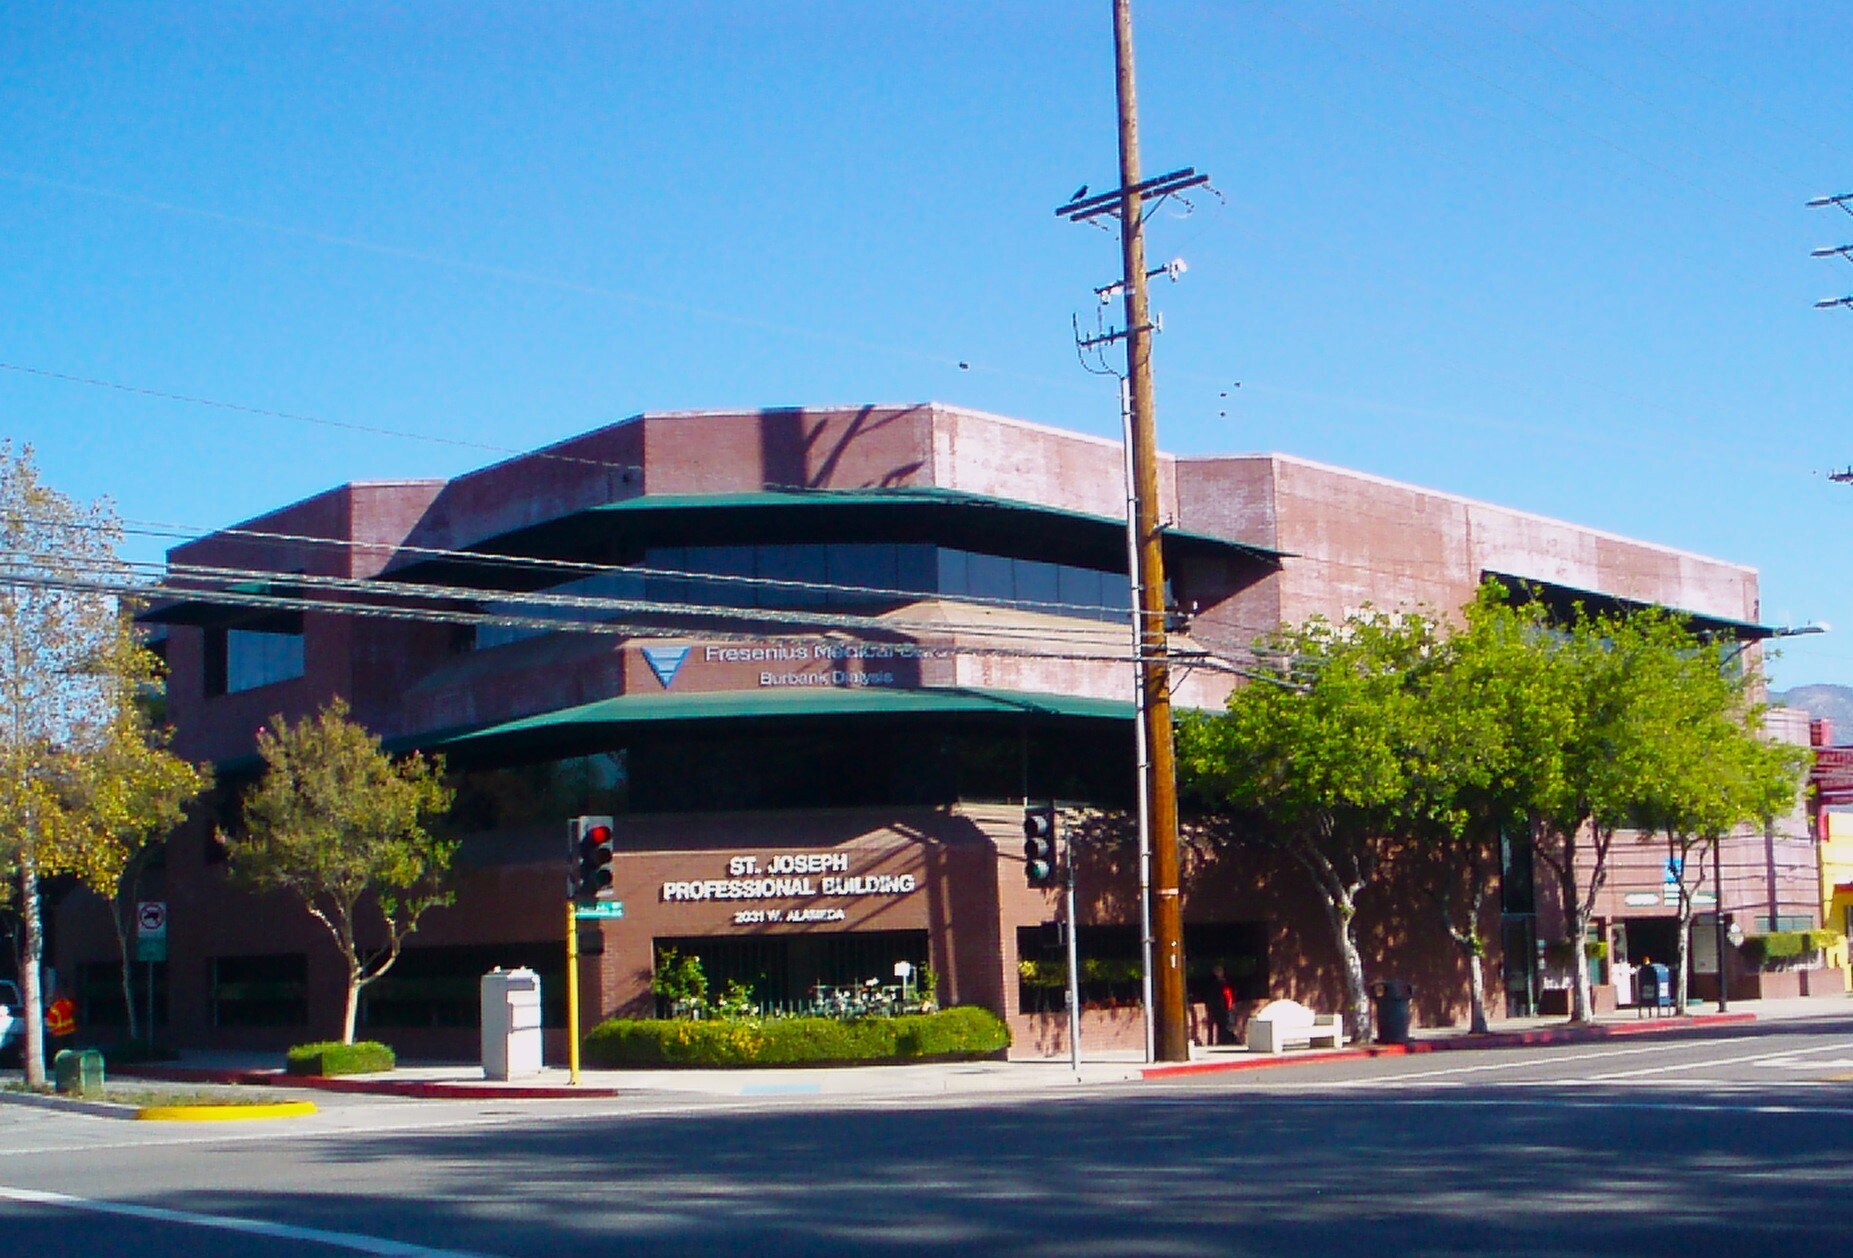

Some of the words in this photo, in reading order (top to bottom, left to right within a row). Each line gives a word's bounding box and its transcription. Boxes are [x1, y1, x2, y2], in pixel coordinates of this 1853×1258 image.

[705, 645, 808, 661] Fresenius
[760, 671, 829, 686] Burbank
[729, 856, 762, 875] ST.
[767, 853, 849, 874] JOSEPH
[662, 877, 816, 901] PROFESSIONAL
[821, 874, 916, 895] BUILDING
[785, 908, 846, 922] ALAMEDA
